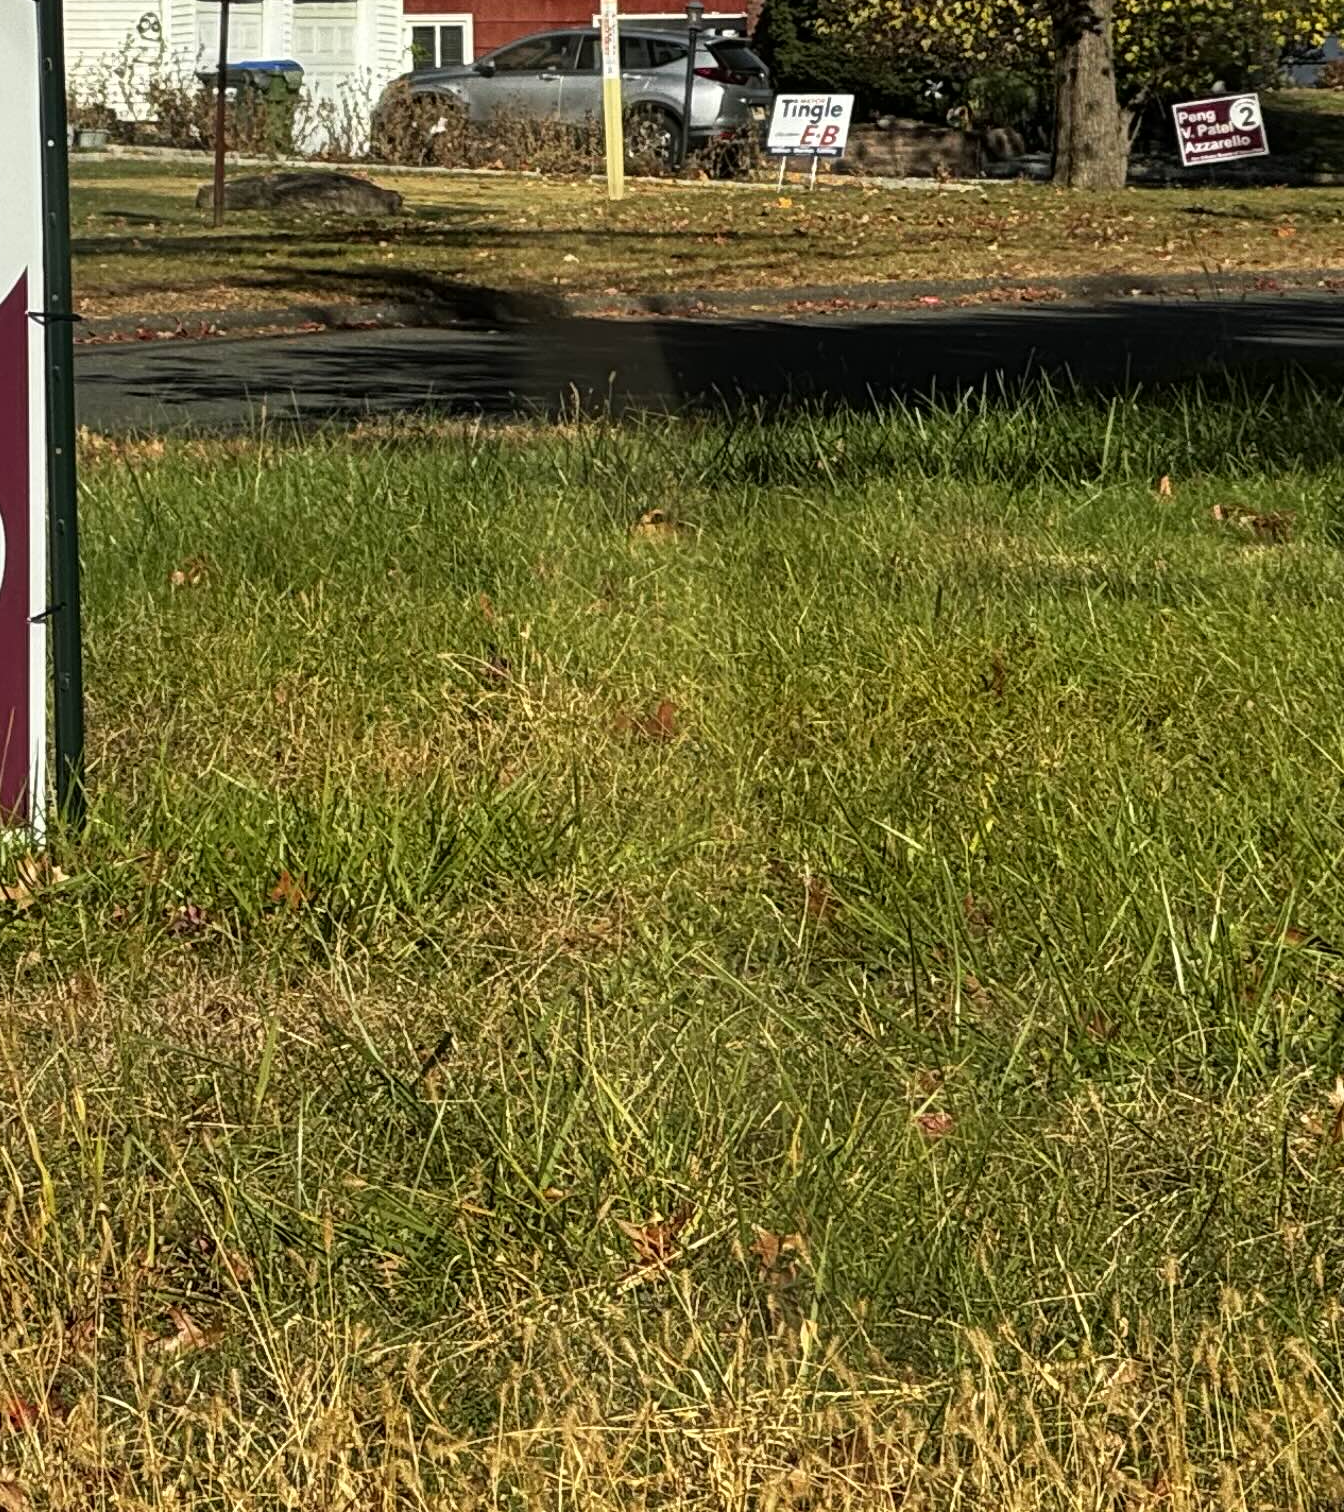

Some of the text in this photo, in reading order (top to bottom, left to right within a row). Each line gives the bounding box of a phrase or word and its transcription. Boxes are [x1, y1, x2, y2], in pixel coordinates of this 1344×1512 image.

[782, 96, 843, 124] Tingle
[1178, 110, 1217, 125] Peng
[1240, 107, 1256, 127] 2
[1197, 121, 1235, 137] Patel
[1184, 135, 1252, 154] Azzarello
